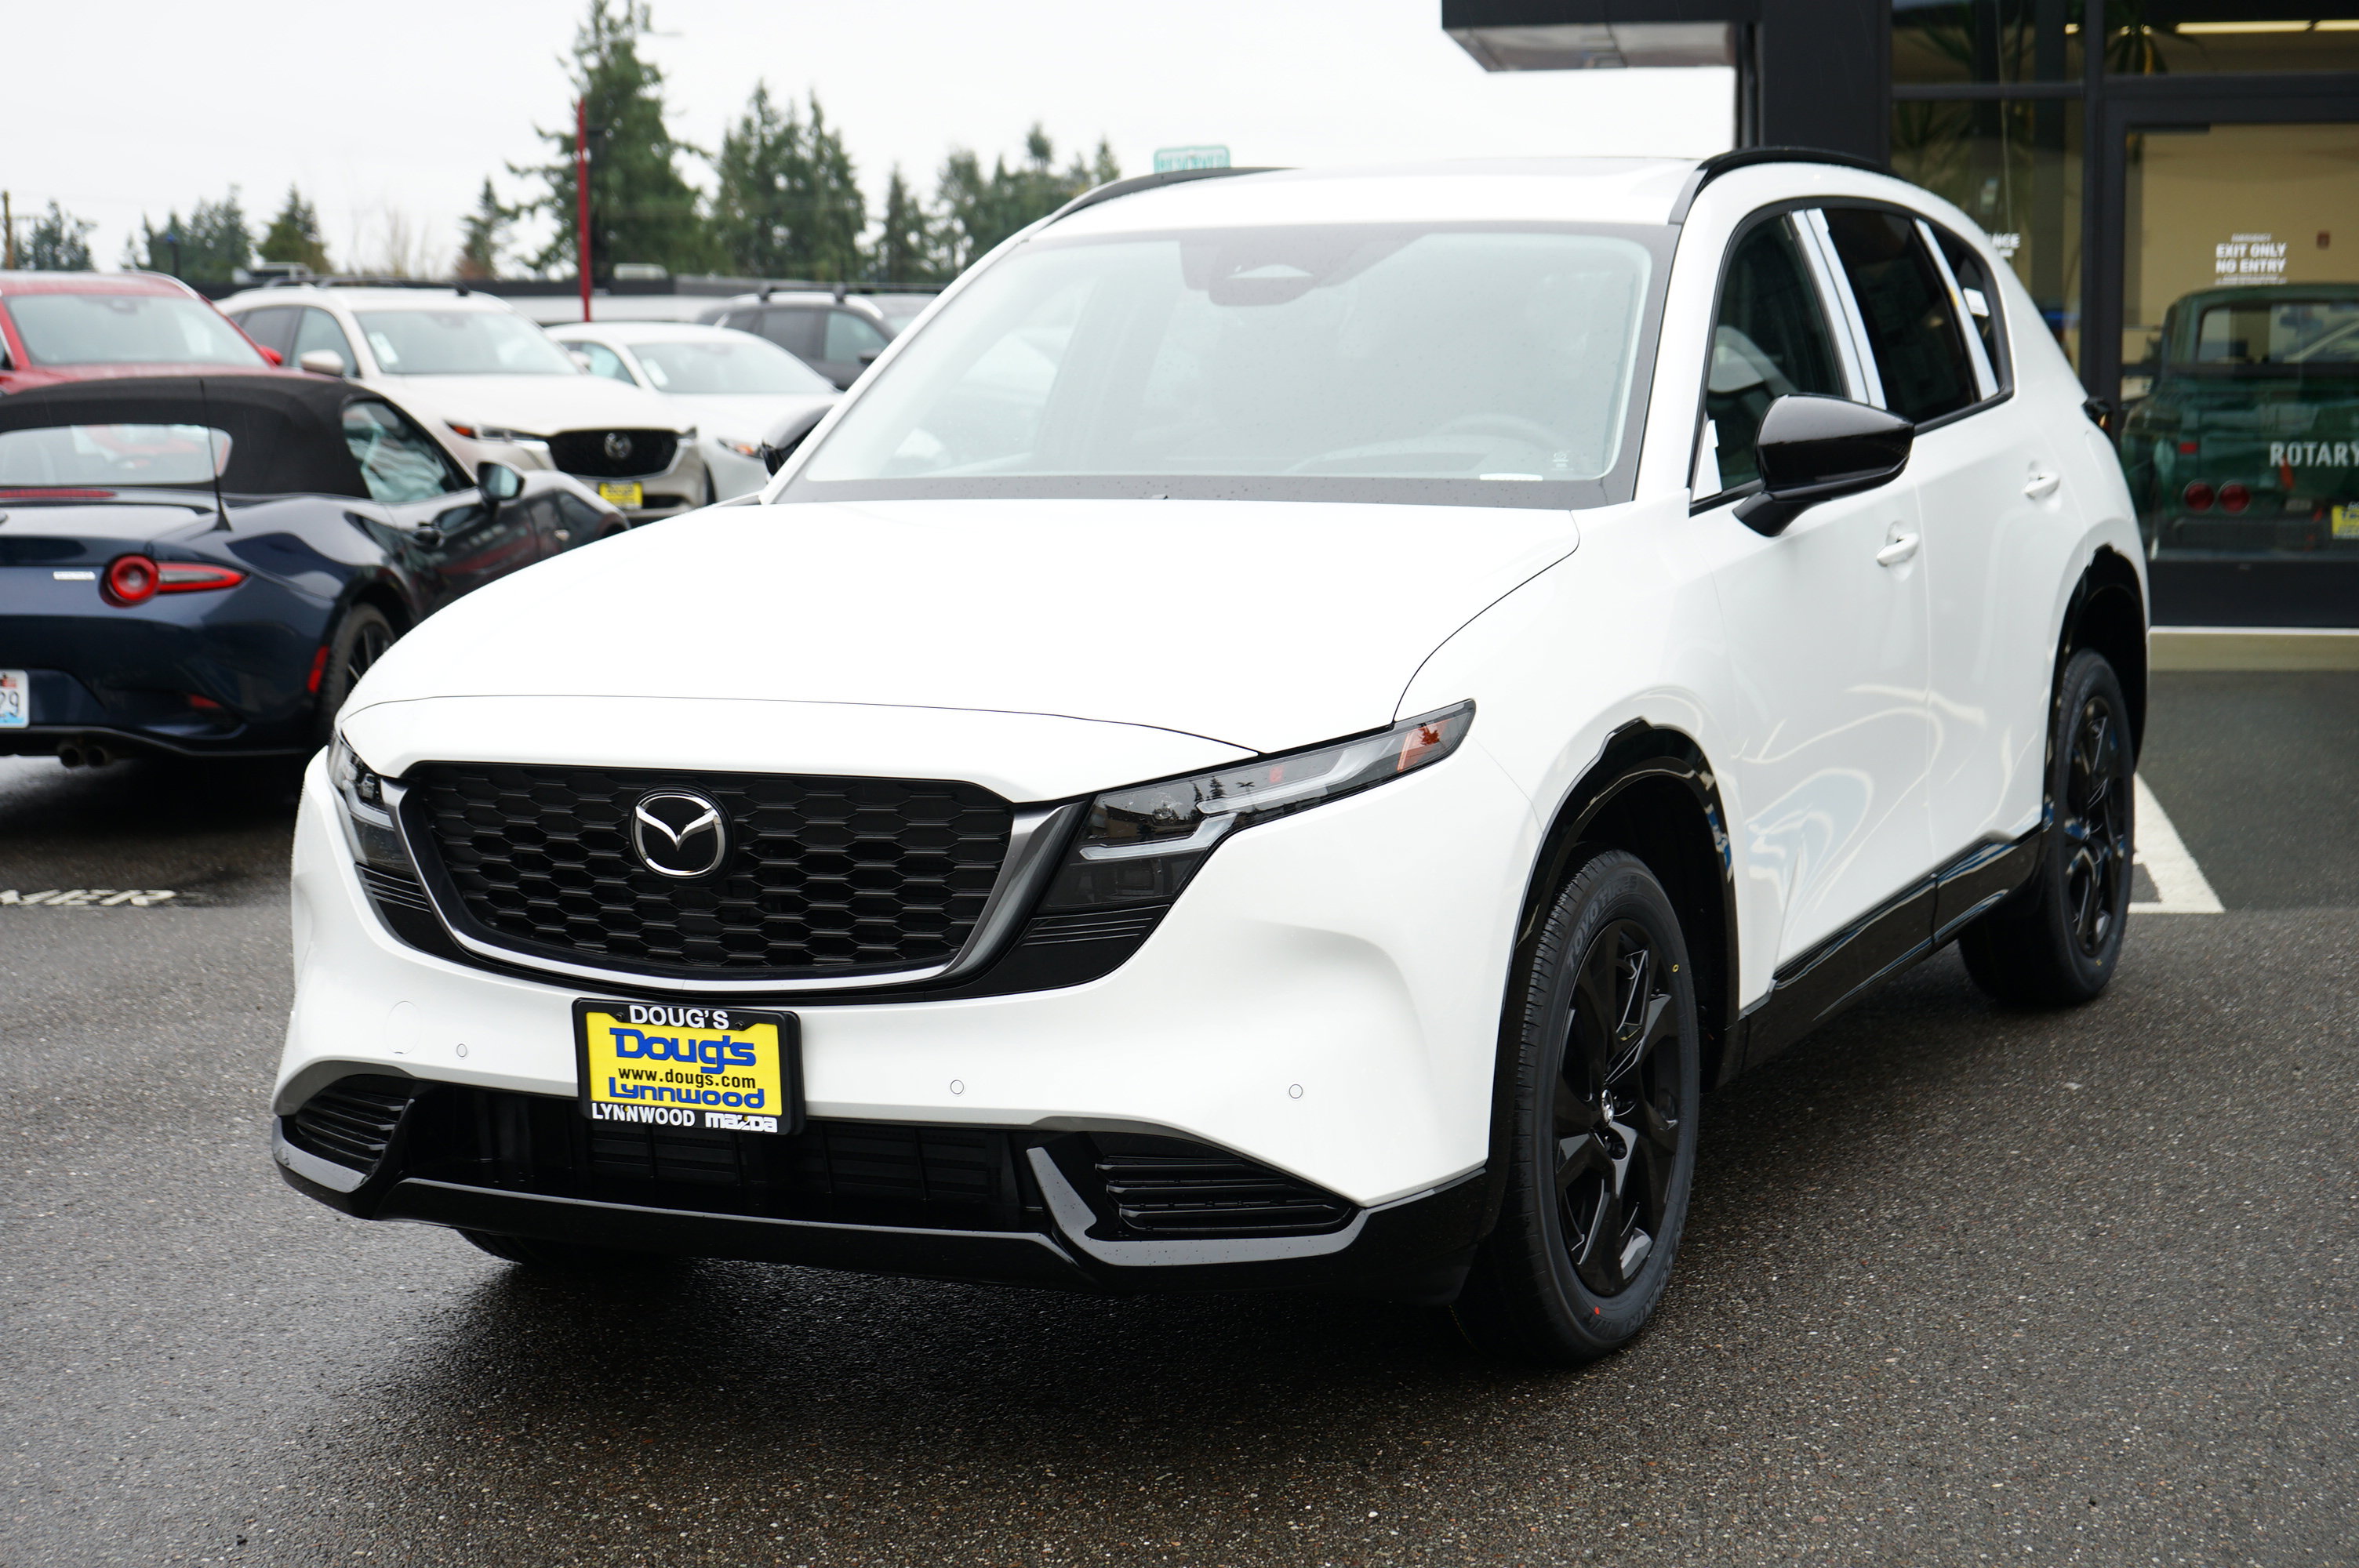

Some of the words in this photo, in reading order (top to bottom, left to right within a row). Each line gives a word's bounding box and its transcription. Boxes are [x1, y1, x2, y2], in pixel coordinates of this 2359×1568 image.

[2215, 242, 2248, 258] EXIT
[2250, 241, 2288, 258] ONLY
[2215, 258, 2236, 274] NO
[2240, 257, 2287, 273] ENTRY
[628, 1004, 729, 1029] DOUG'S
[609, 1027, 757, 1075] Doug's
[618, 1067, 756, 1089] www.dougs.com
[609, 1076, 765, 1109] Lynnwood
[591, 1102, 696, 1127] LYNNWOOD
